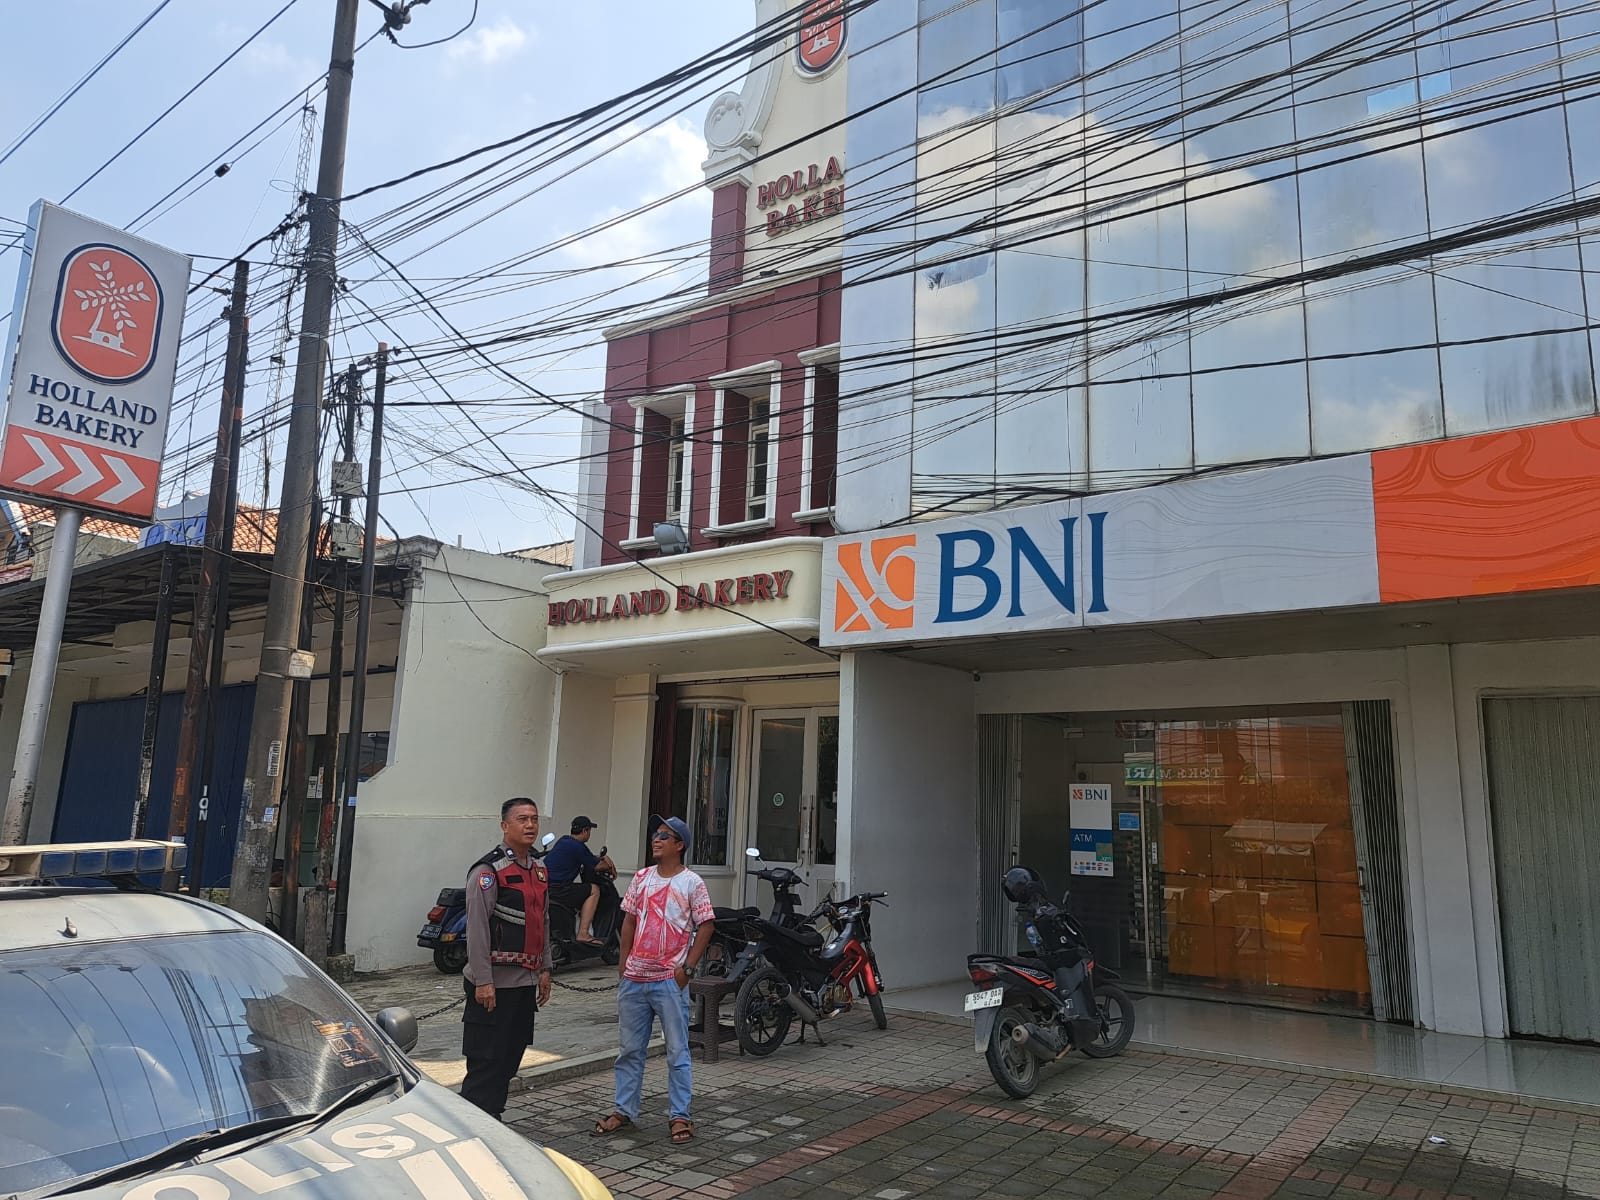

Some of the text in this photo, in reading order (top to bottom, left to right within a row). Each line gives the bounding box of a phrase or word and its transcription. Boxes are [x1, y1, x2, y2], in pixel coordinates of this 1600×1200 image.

[756, 156, 844, 210] HOLLA
[28, 373, 158, 426] HOLLAND
[35, 402, 144, 449] BAKERY
[933, 511, 1109, 624] BNI
[547, 569, 794, 626] HOLLAND BAKERY
[1085, 789, 1107, 800] BNI
[1074, 833, 1093, 842] ATM
